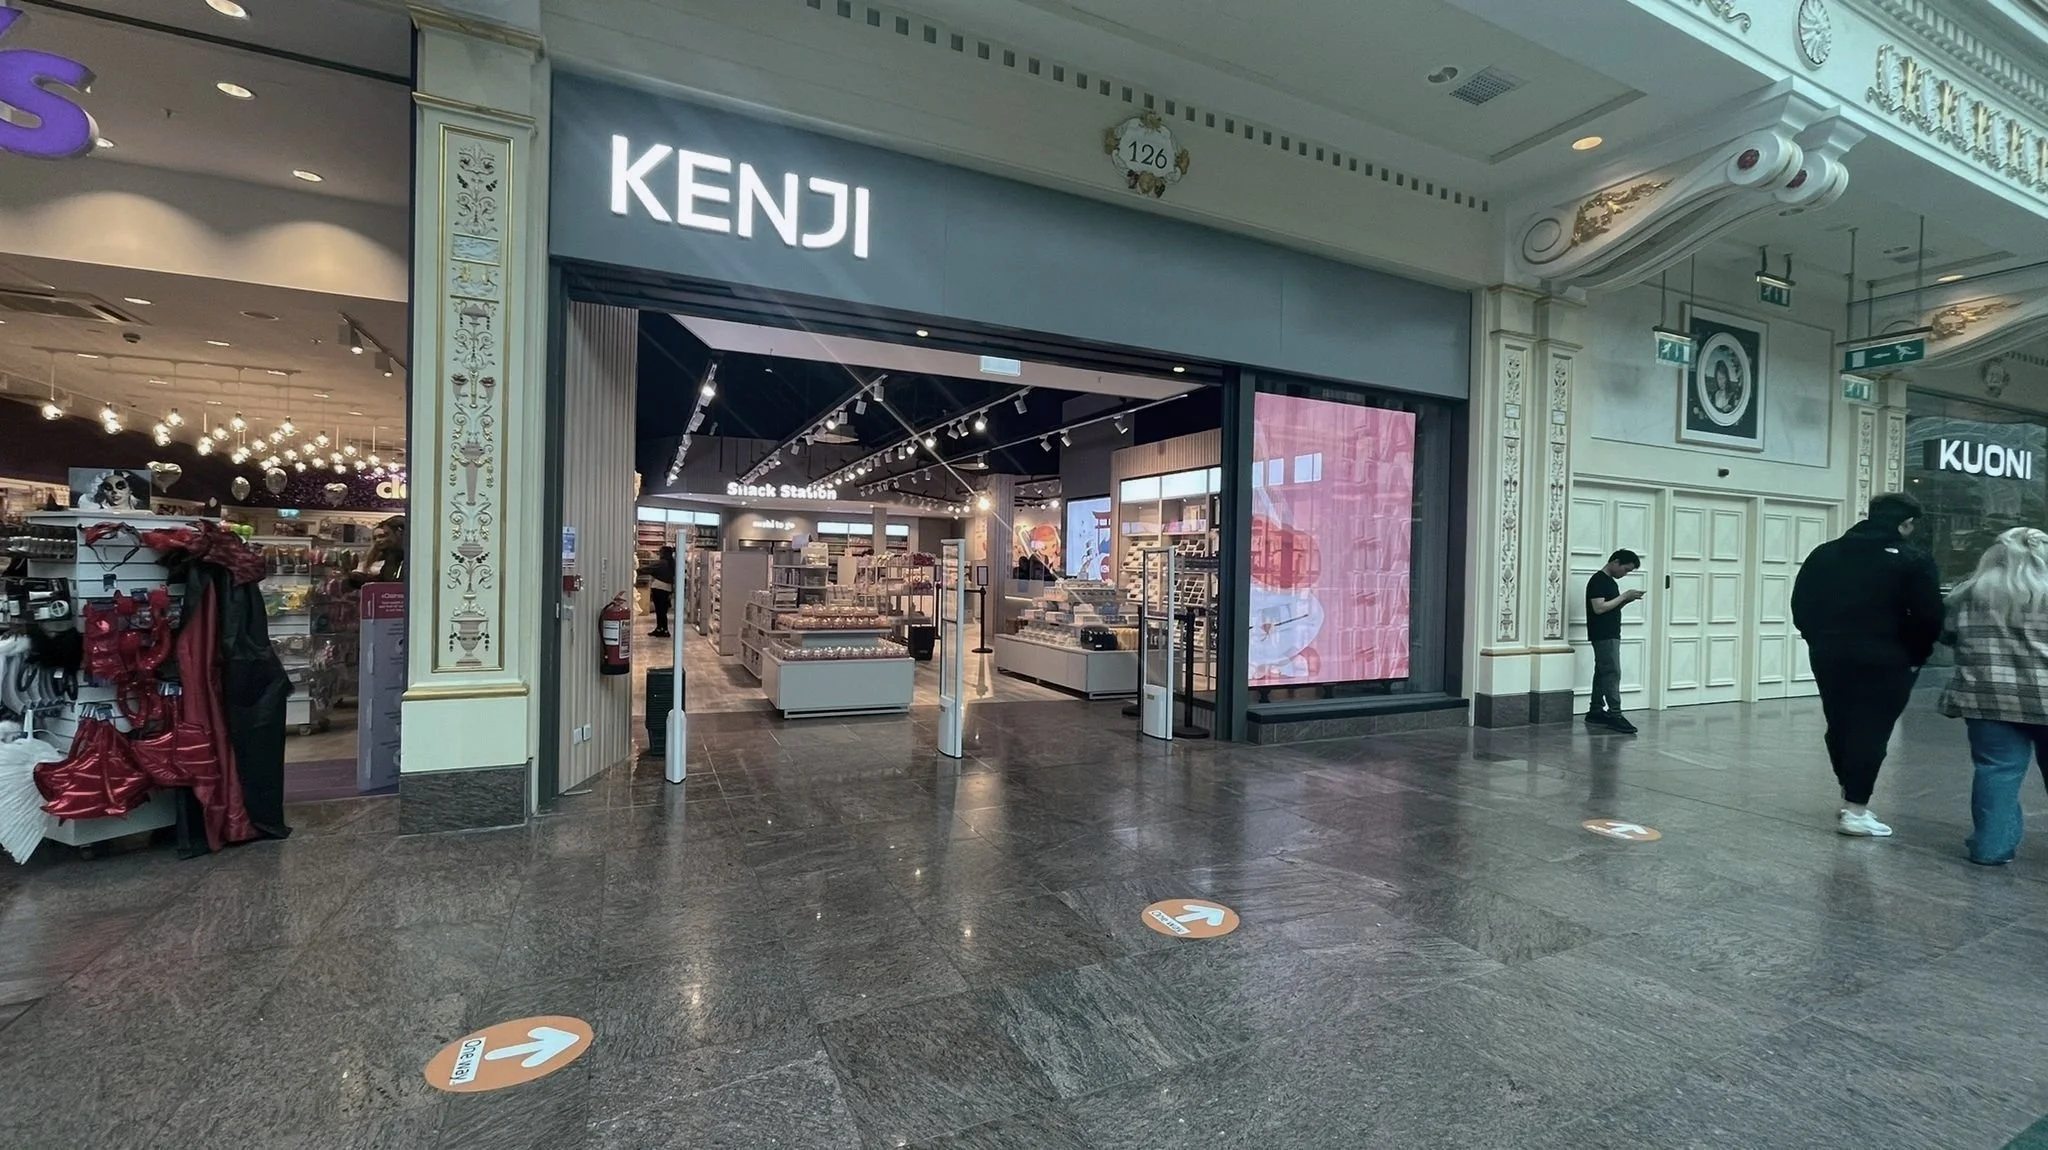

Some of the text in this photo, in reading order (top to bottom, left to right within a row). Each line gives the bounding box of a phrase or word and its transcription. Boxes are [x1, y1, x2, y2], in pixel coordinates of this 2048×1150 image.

[1128, 141, 1168, 169] 126
[611, 134, 870, 259] KENJI
[1940, 439, 2032, 480] KUONI
[727, 482, 837, 500] Snack Station
[449, 1040, 482, 1080] One way
